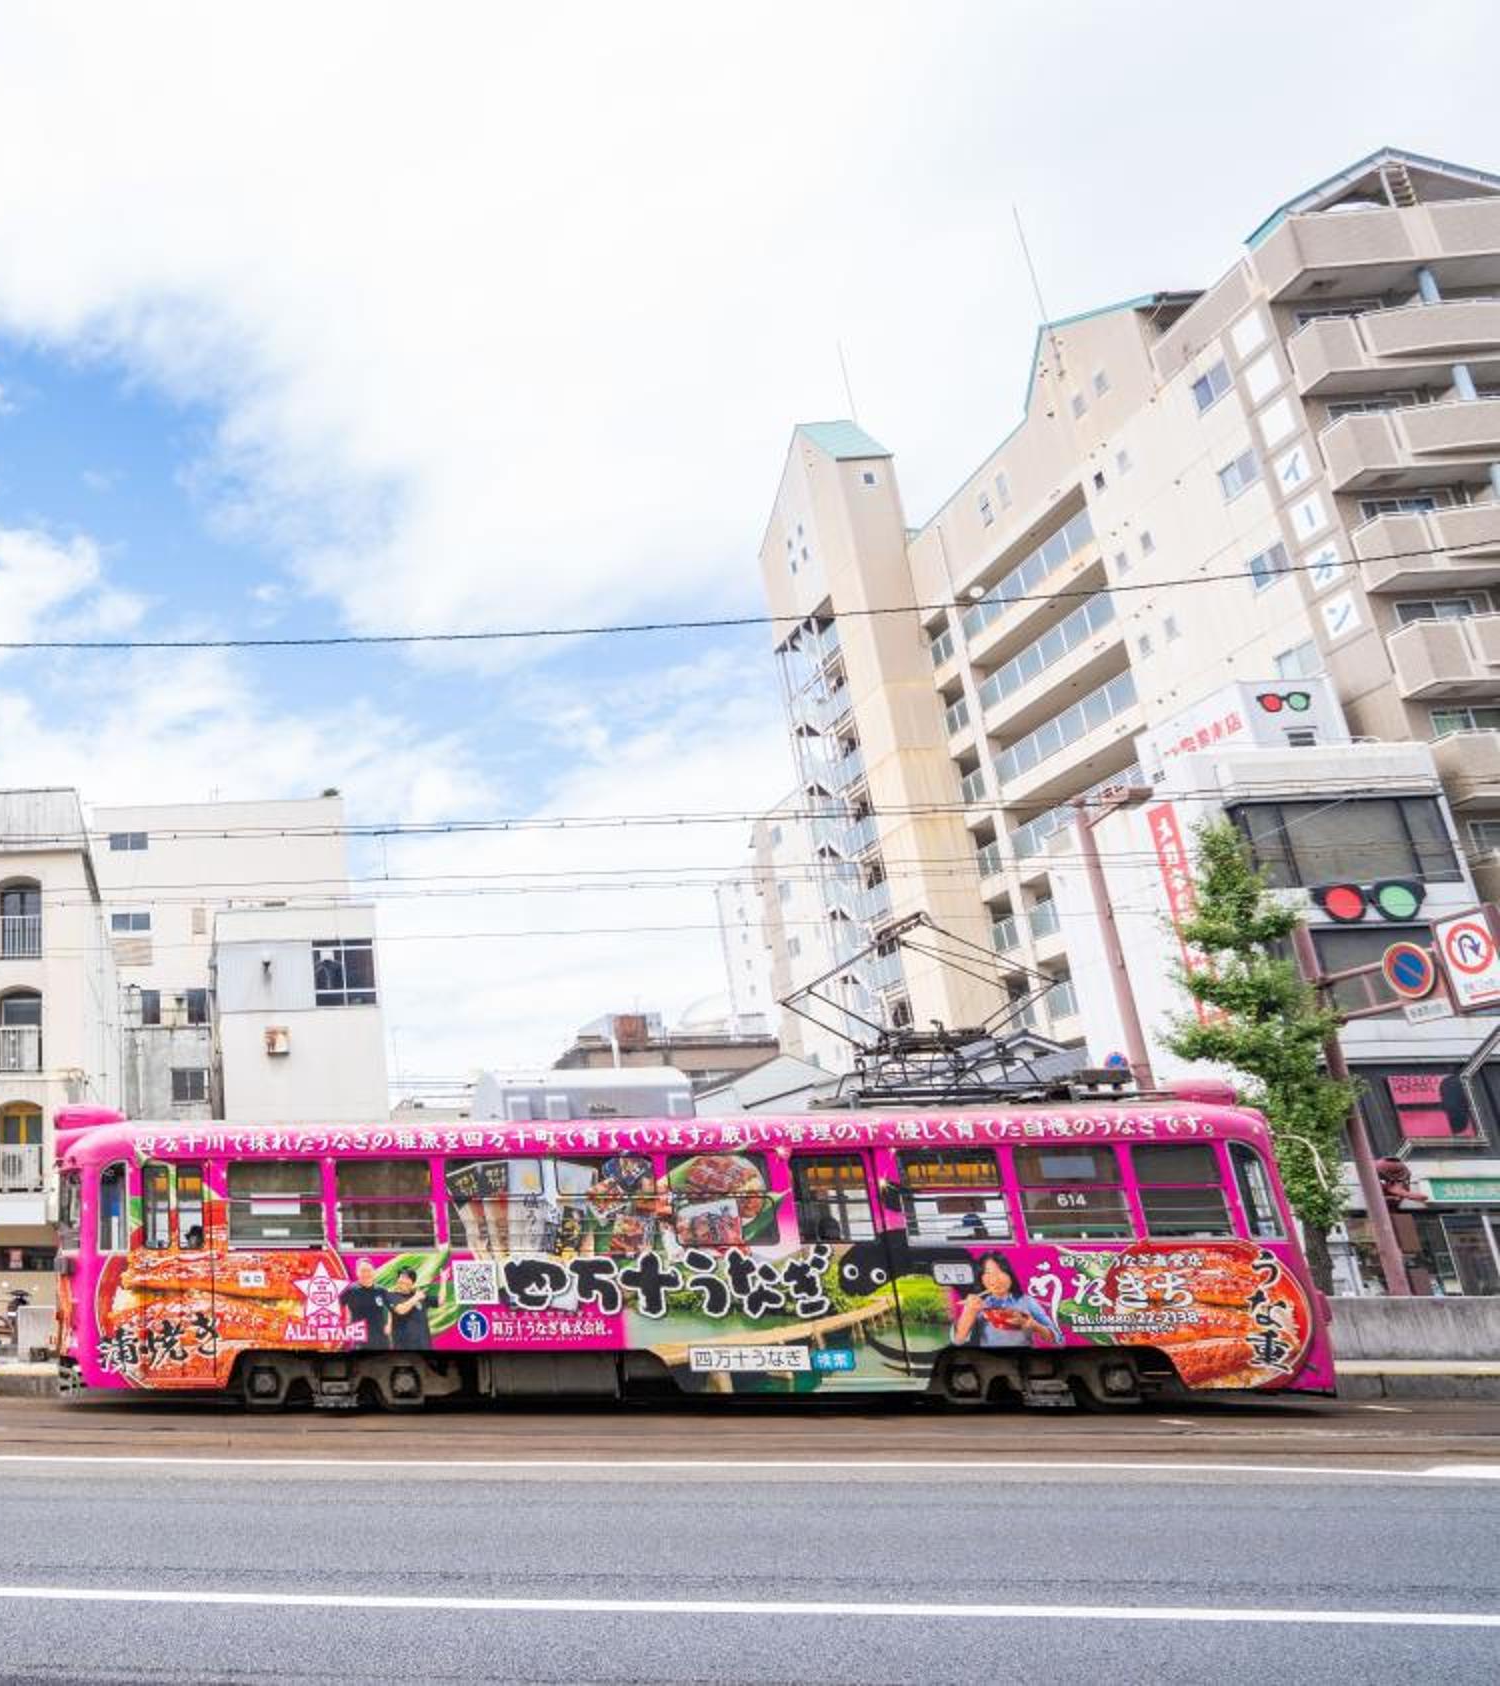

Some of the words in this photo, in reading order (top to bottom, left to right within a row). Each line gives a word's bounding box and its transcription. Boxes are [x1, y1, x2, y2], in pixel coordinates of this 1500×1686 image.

[1056, 1193, 1088, 1208] 614
[503, 1244, 830, 1318] 四万十うなぎ
[1246, 1250, 1294, 1374] うな重
[285, 1322, 317, 1341] ALL
[317, 1320, 368, 1342] STARS
[97, 1311, 223, 1374] 蒲焼き
[694, 1350, 802, 1368] 四万十うなぎ
[816, 1352, 850, 1369] 検索
